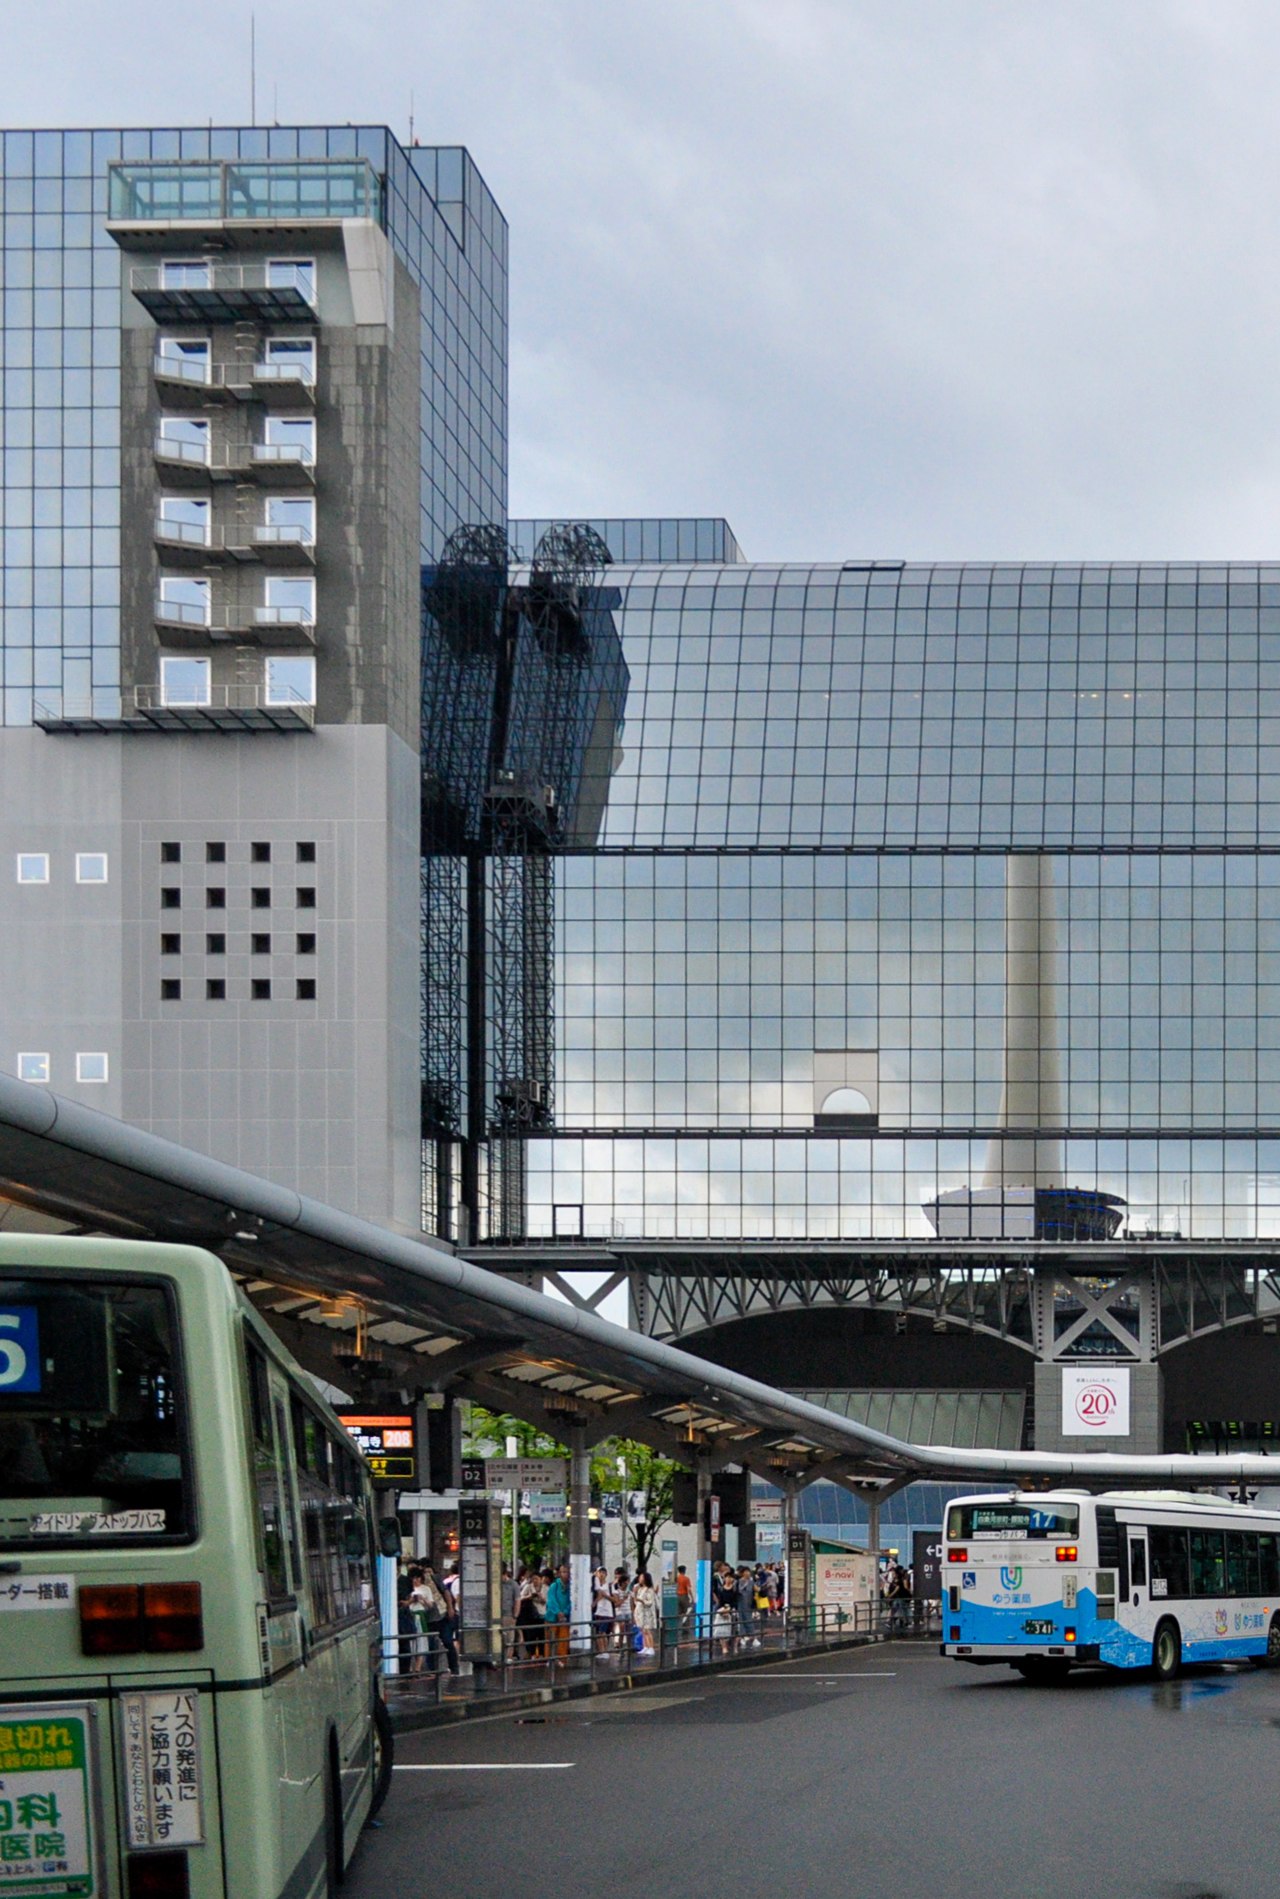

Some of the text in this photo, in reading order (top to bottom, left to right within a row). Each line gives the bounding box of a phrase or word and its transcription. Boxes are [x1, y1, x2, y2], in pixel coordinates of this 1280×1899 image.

[387, 1431, 410, 1447] 208
[465, 1471, 480, 1480] D2
[466, 1520, 482, 1529] D2
[1032, 1512, 1053, 1528] 17
[924, 1564, 933, 1572] D1
[174, 1693, 199, 1802] バスの発進に
[0, 1751, 73, 1769] 器の治療
[150, 1713, 174, 1839] ご協力願います
